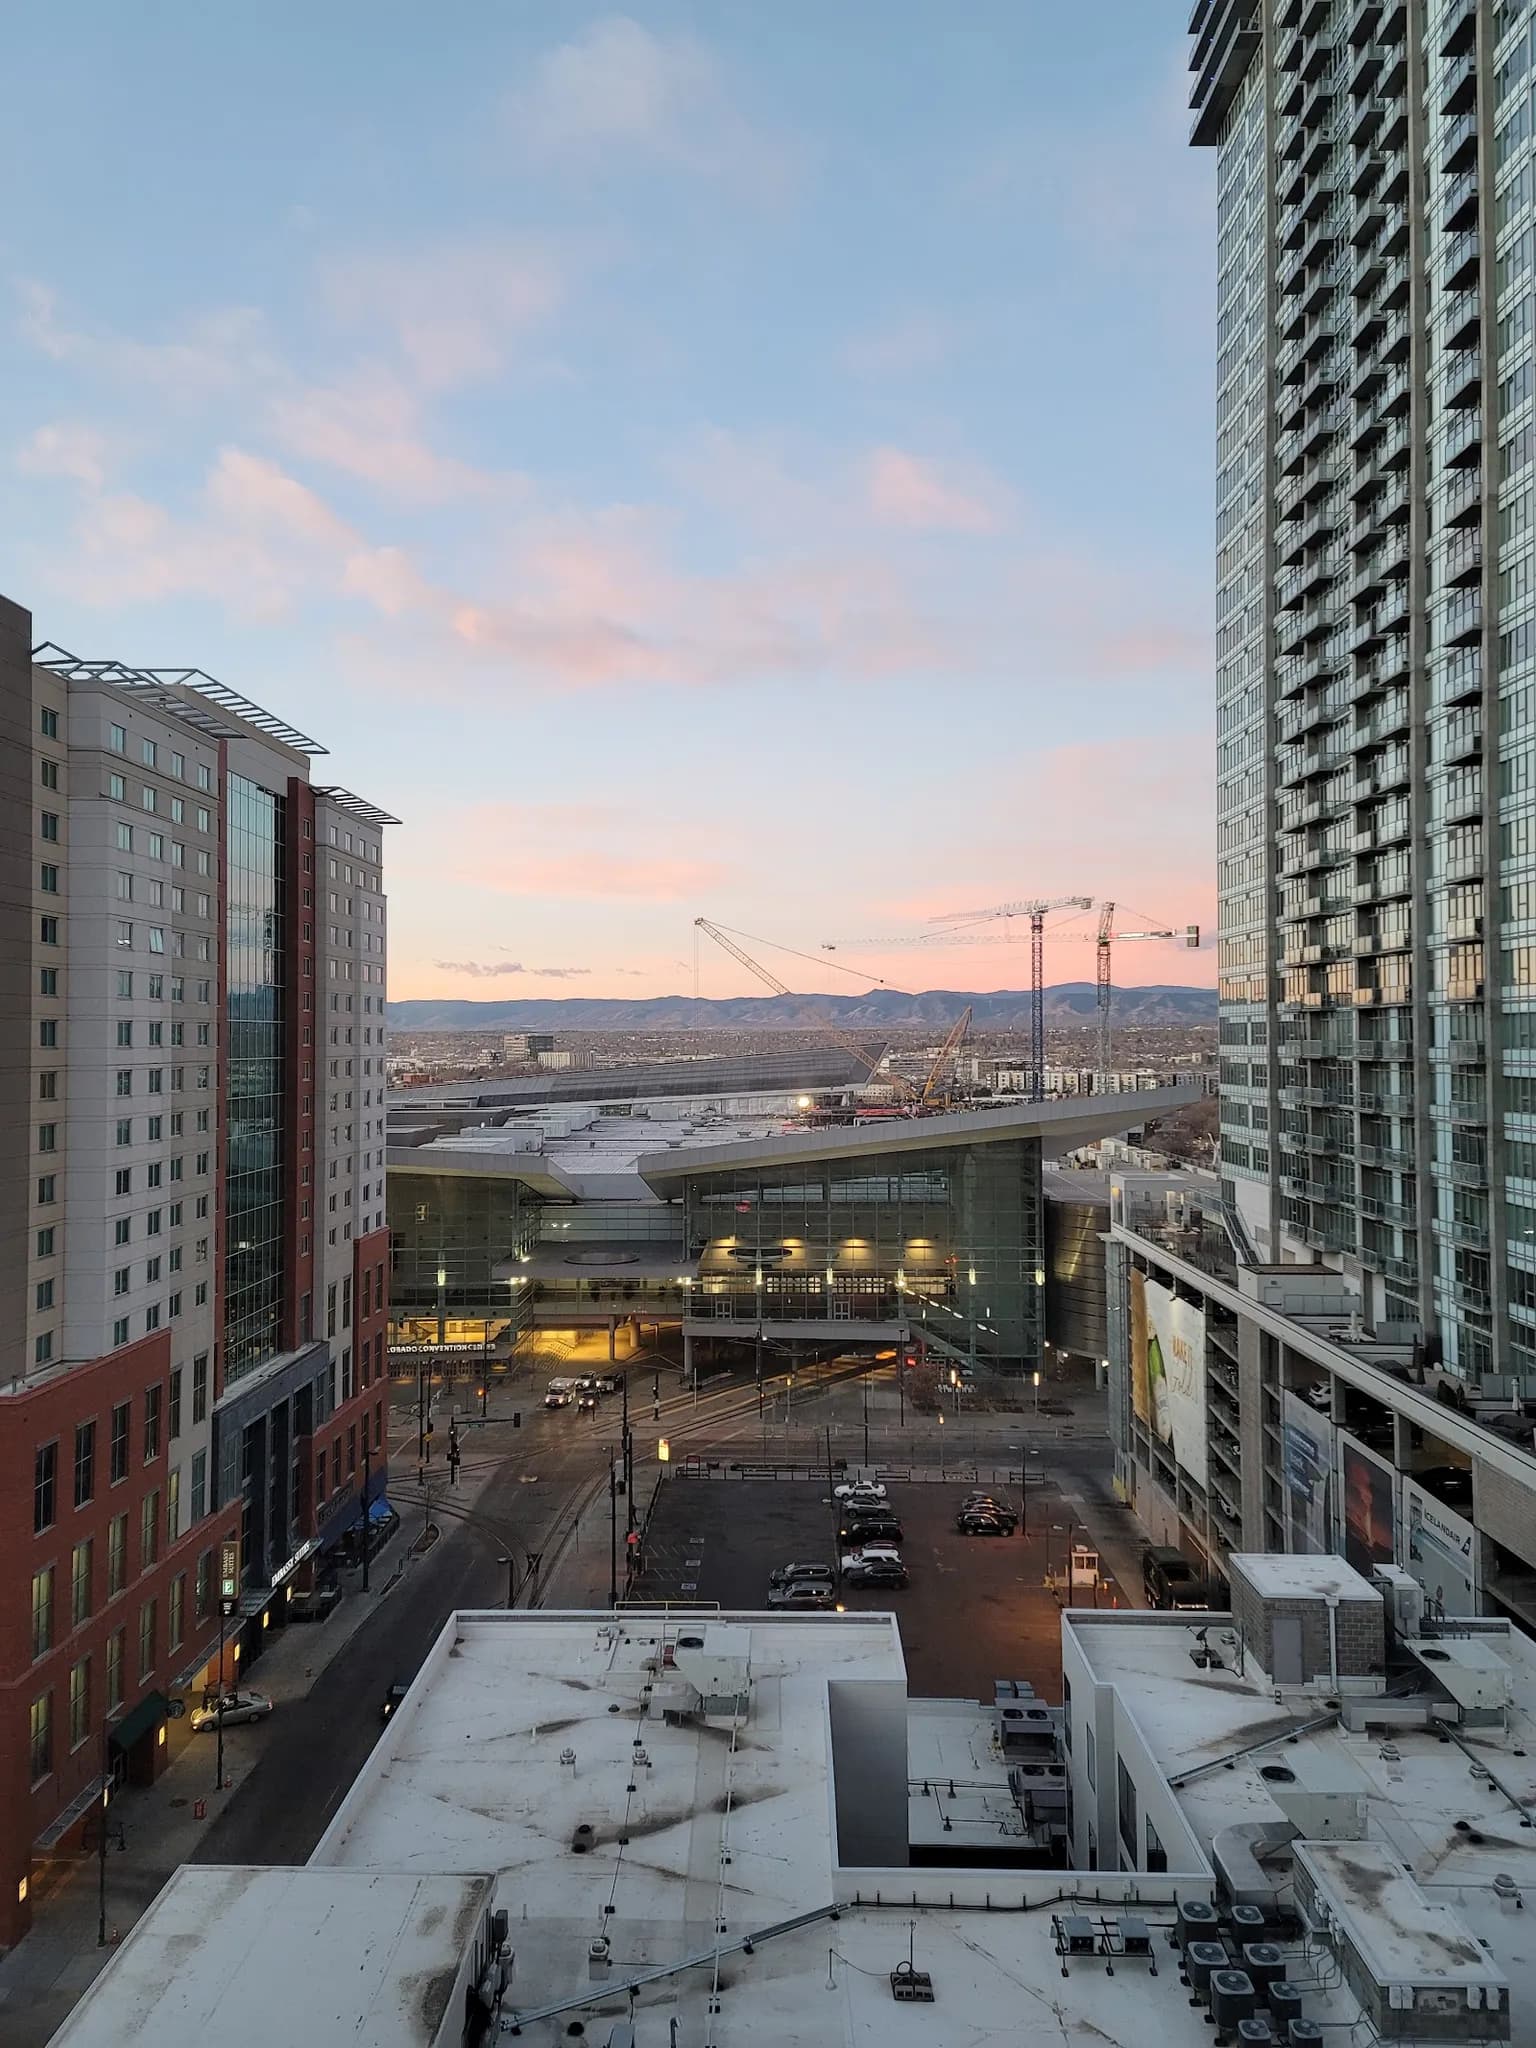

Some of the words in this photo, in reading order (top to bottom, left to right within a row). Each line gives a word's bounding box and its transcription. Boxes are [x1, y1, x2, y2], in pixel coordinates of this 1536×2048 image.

[387, 1344, 417, 1353] LORADO
[419, 1343, 466, 1353] CONVENTION
[1424, 1508, 1461, 1544] ICELANDAIR
[272, 1556, 294, 1588] EMBASSY
[294, 1540, 310, 1564] SUITES
